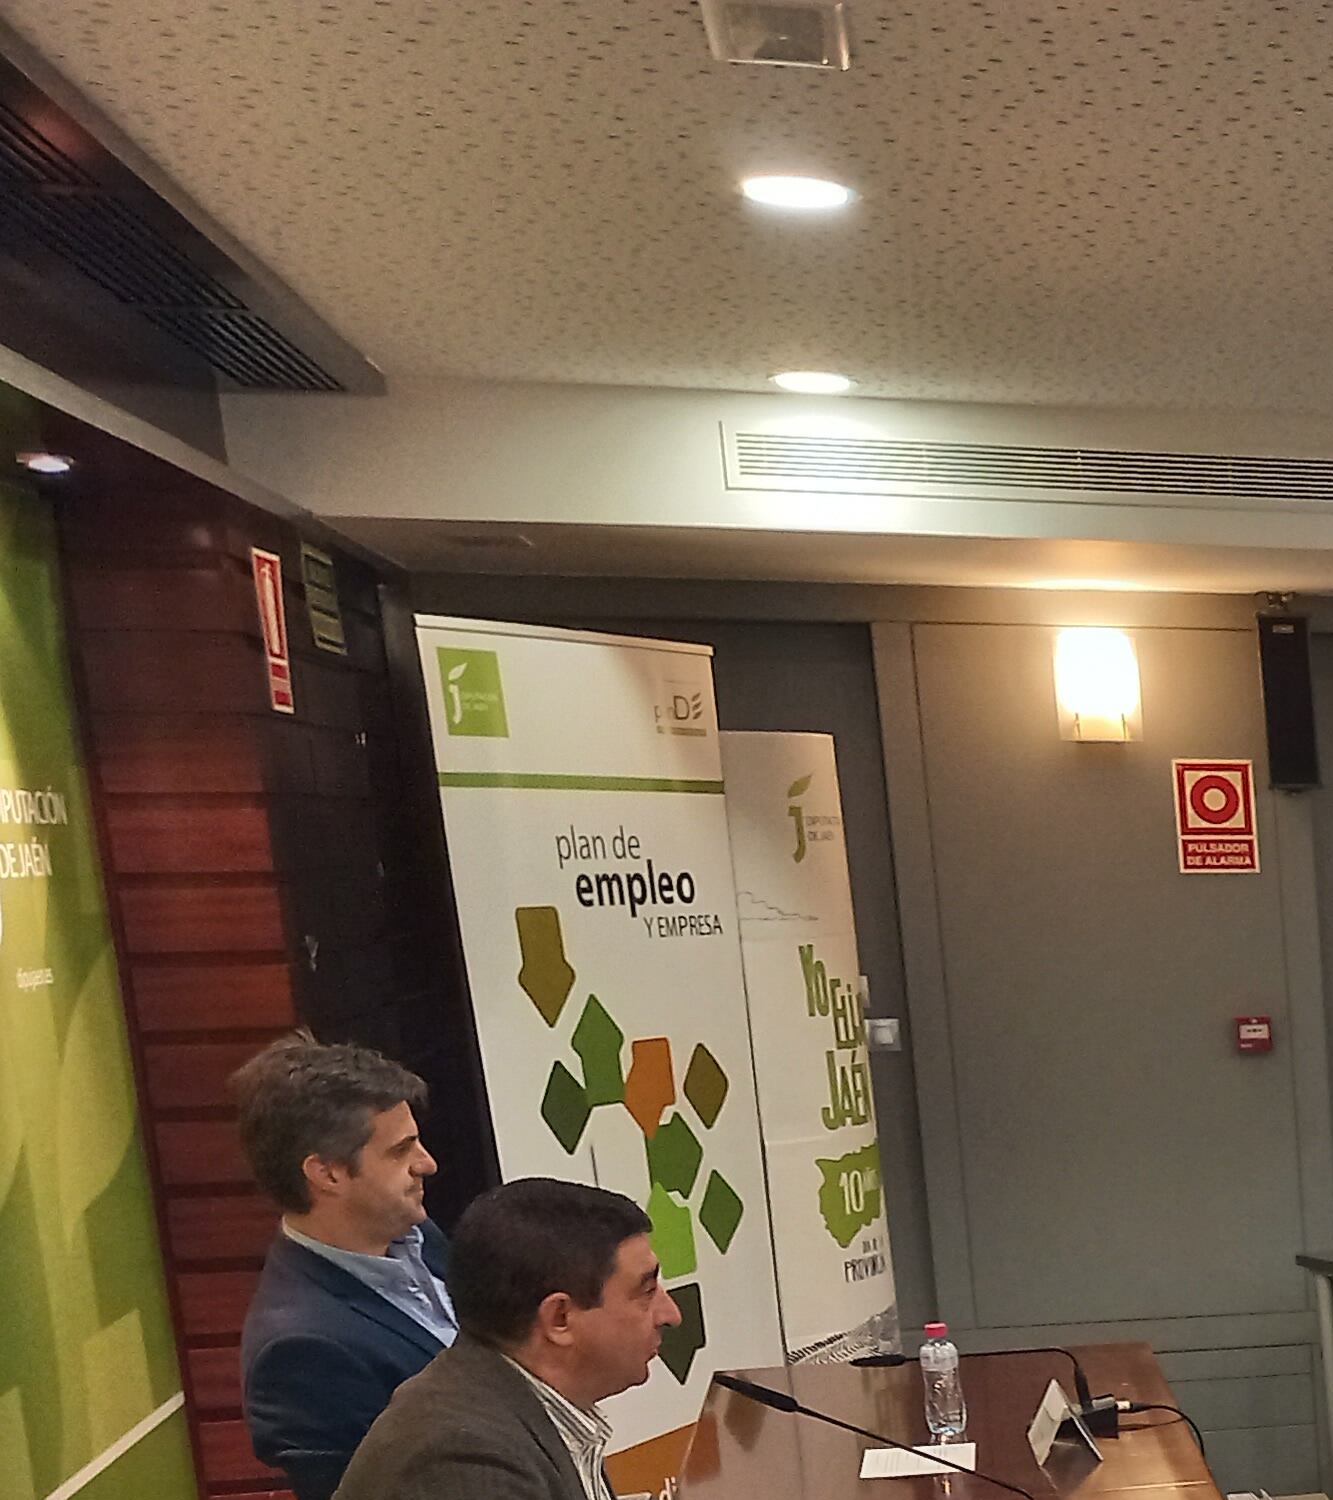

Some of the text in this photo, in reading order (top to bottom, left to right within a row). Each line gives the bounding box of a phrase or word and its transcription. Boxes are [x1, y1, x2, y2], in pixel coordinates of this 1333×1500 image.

[0, 836, 53, 879] DE JAÉN
[555, 824, 641, 870] plan de
[1186, 855, 1252, 866] DE ALARMA
[1187, 842, 1250, 853] PULSADOR
[575, 858, 696, 919] empleo
[643, 914, 723, 939] Y EMPRESA
[839, 1170, 864, 1215] 10
